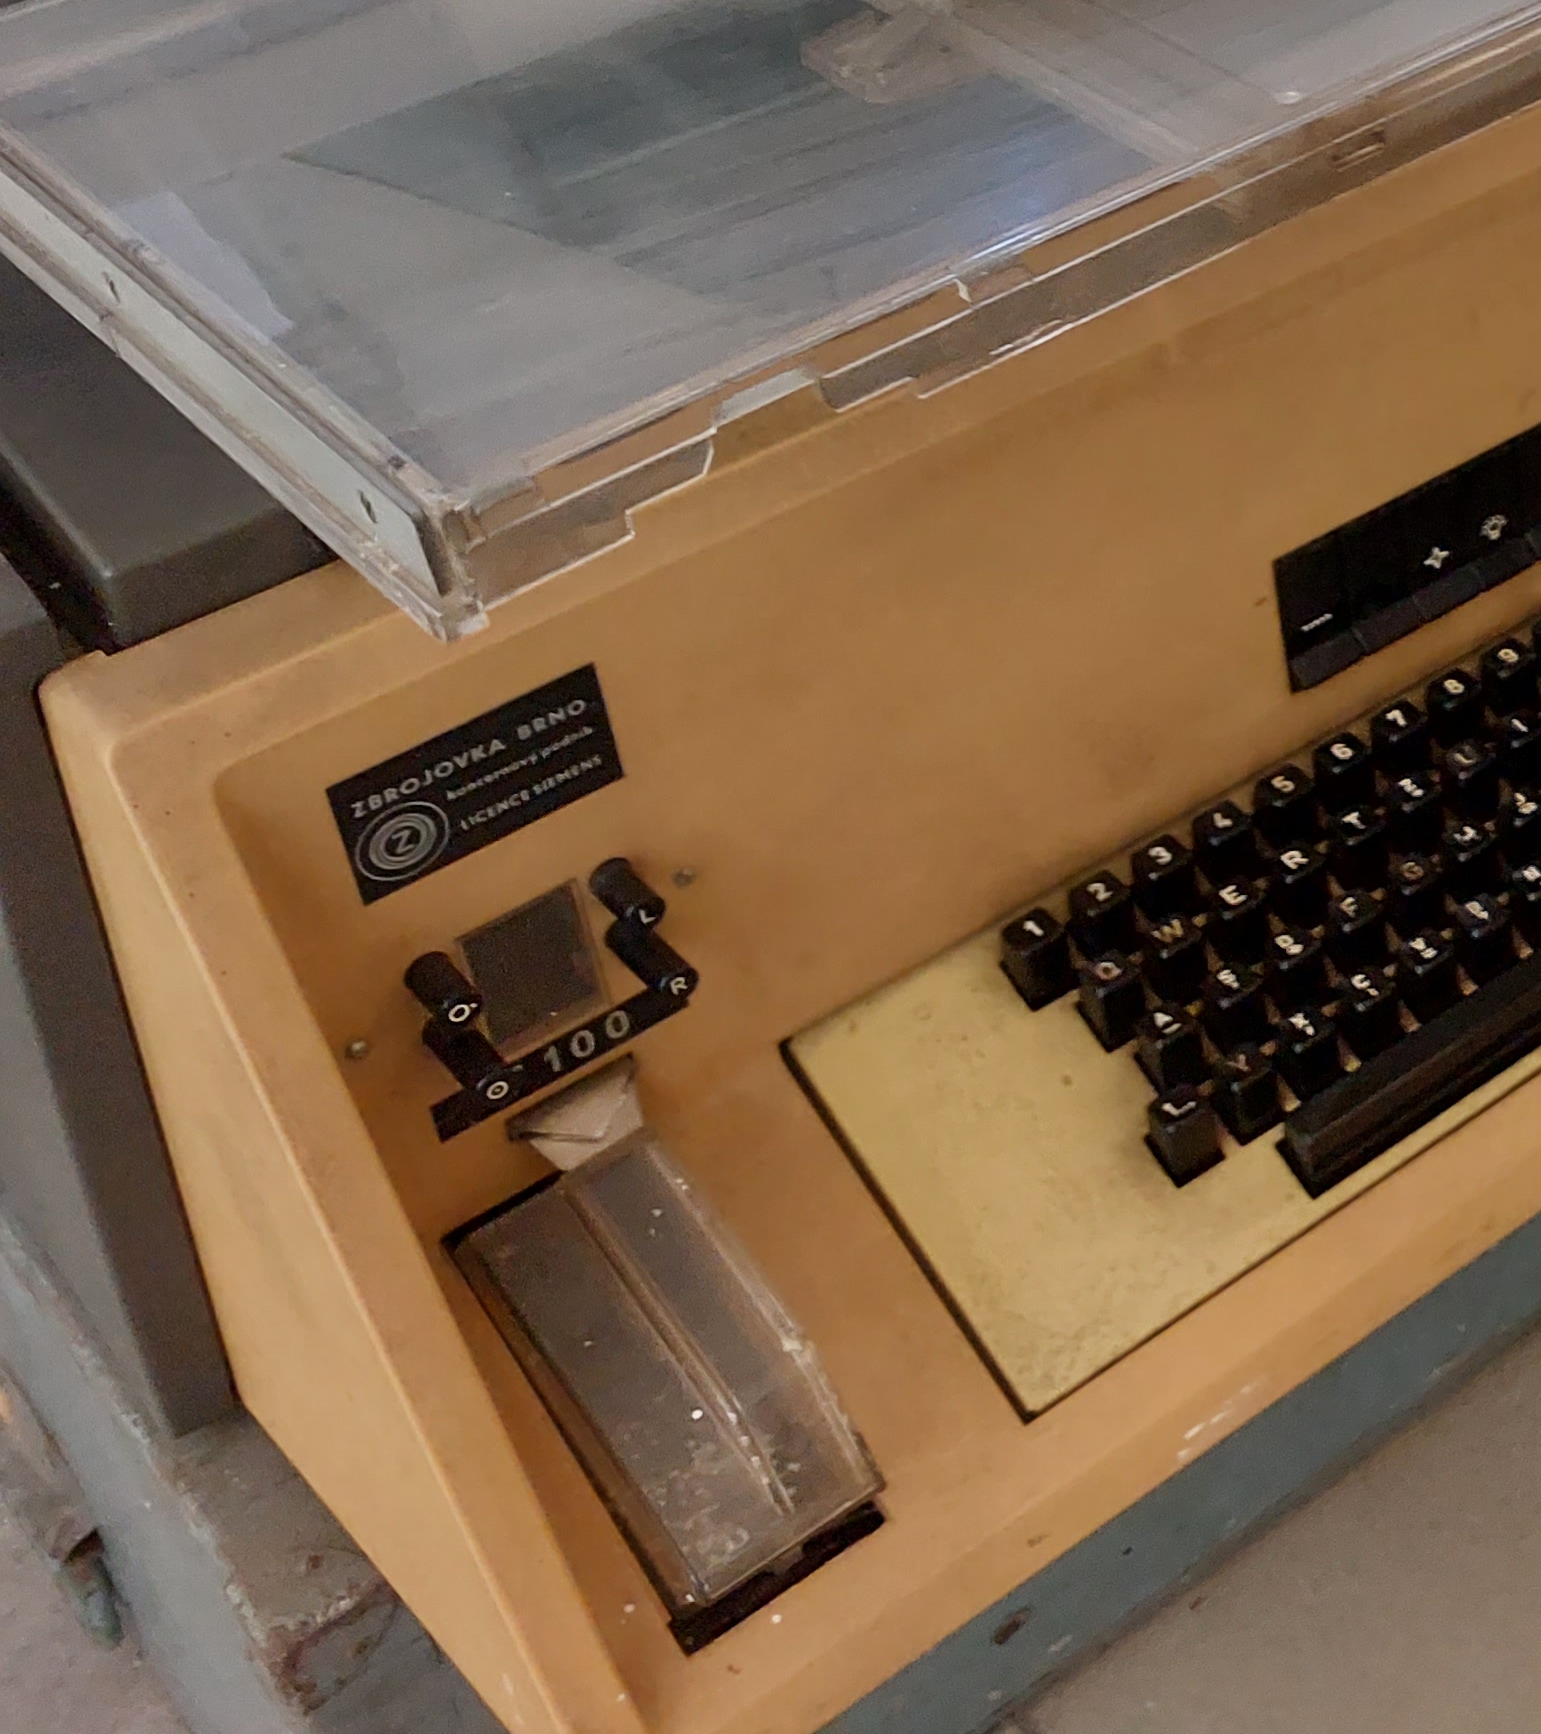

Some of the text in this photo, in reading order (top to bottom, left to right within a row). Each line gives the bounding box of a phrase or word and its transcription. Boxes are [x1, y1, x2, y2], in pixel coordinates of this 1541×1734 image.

[350, 698, 587, 819] ZBROJOVKA BRNO
[459, 752, 603, 832] LICENCE SIEMENS
[1086, 881, 1113, 902] 2
[1330, 743, 1354, 761] 6
[1218, 883, 1248, 907] E
[1280, 849, 1309, 870] R
